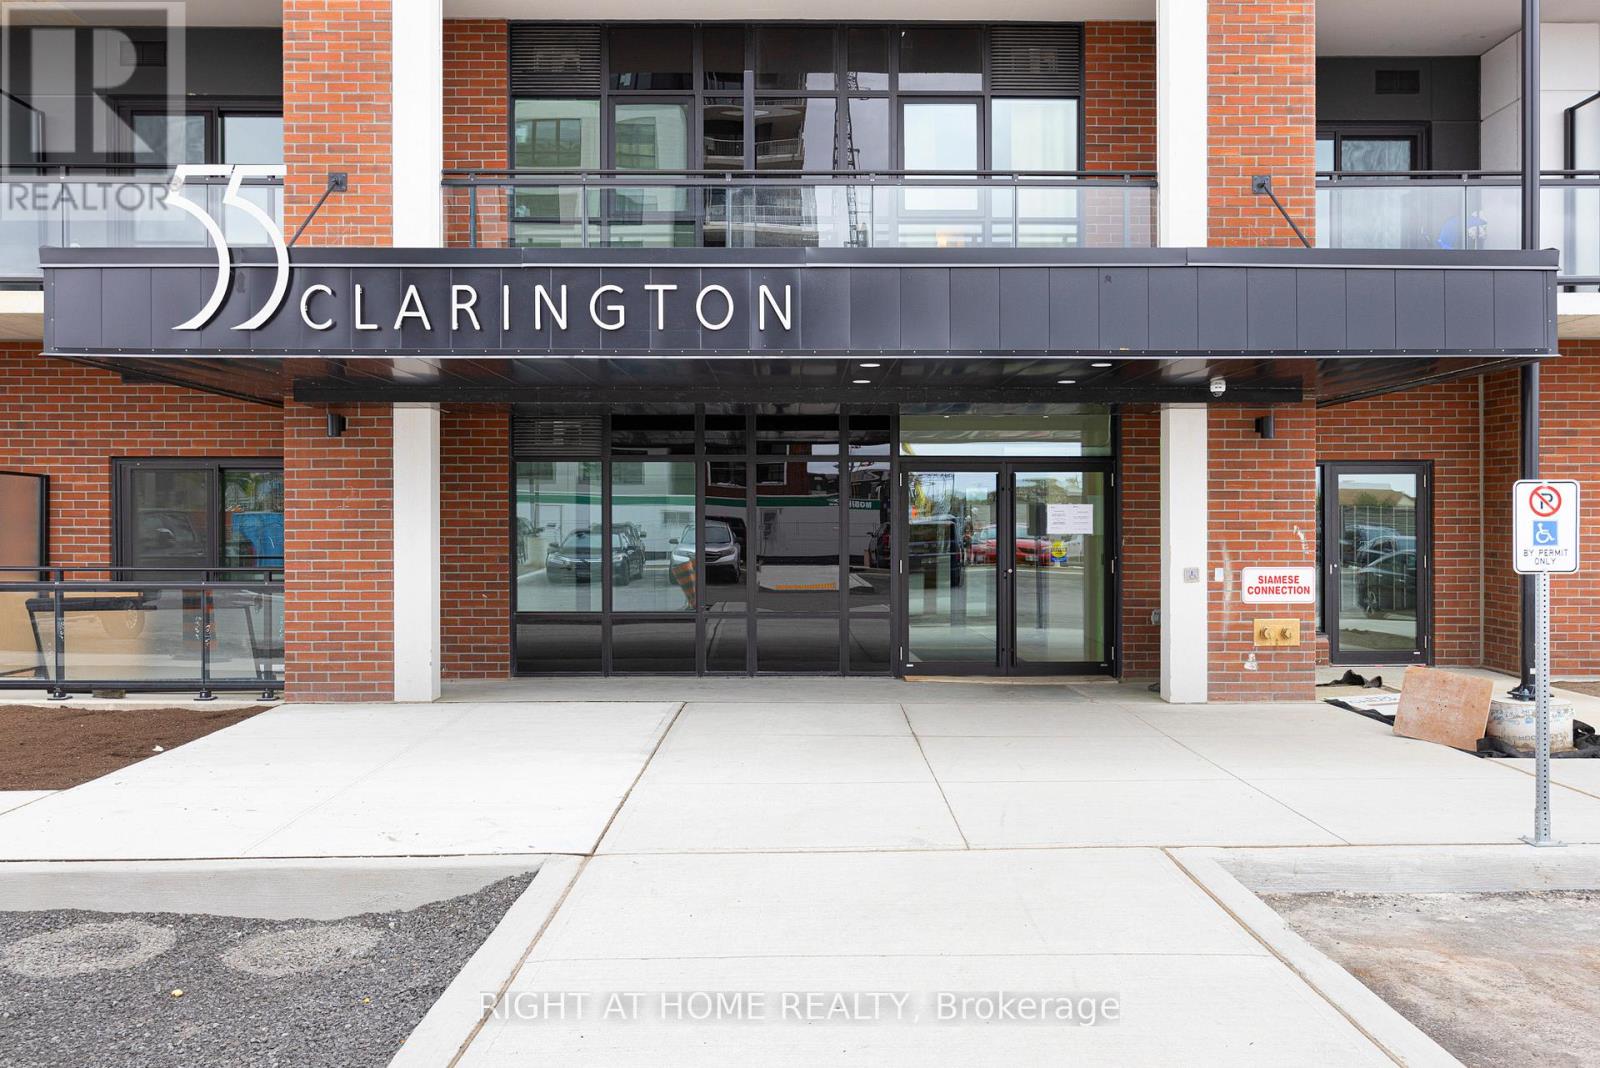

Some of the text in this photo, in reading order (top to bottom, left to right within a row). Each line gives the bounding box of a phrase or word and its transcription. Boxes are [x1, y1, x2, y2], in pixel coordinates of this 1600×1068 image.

[165, 164, 792, 331] 55 CLARINGTON
[1523, 549, 1568, 557] BY PERMIT
[1258, 575, 1300, 584] SIAMESE
[1247, 586, 1310, 594] CONNECTION
